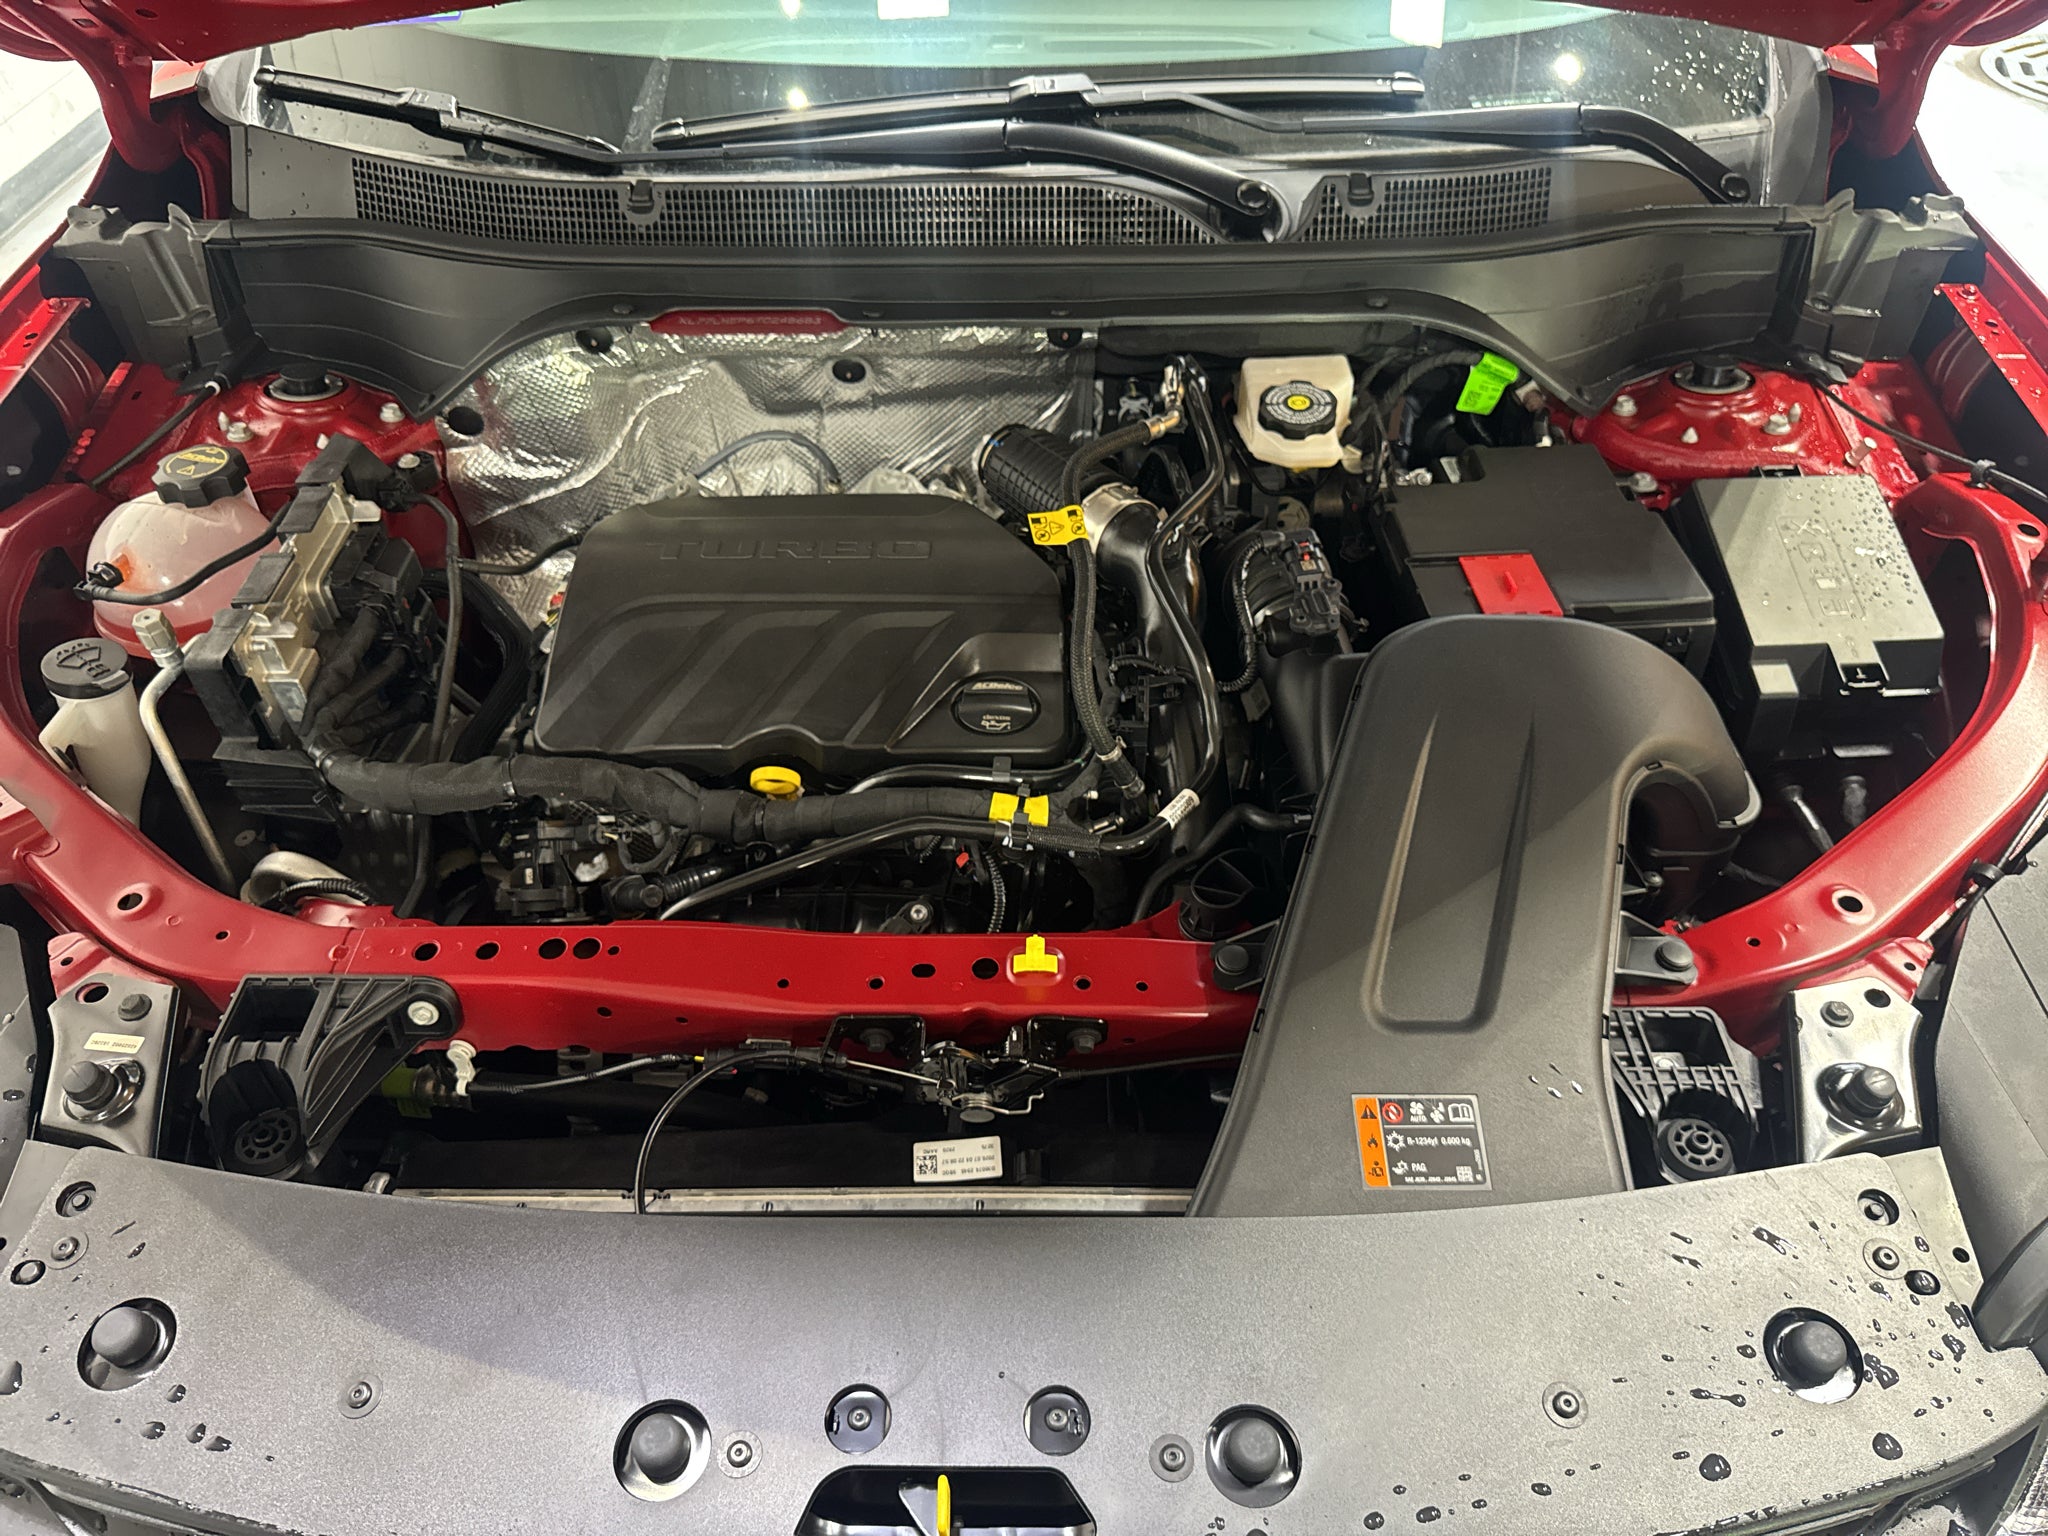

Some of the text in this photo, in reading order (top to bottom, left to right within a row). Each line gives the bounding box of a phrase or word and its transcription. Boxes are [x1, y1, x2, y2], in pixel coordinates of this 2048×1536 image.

[643, 541, 932, 559] TURBO
[972, 682, 1023, 690] ACDelco
[1461, 1137, 1472, 1147] kg
[1412, 1163, 1427, 1171] PAG
